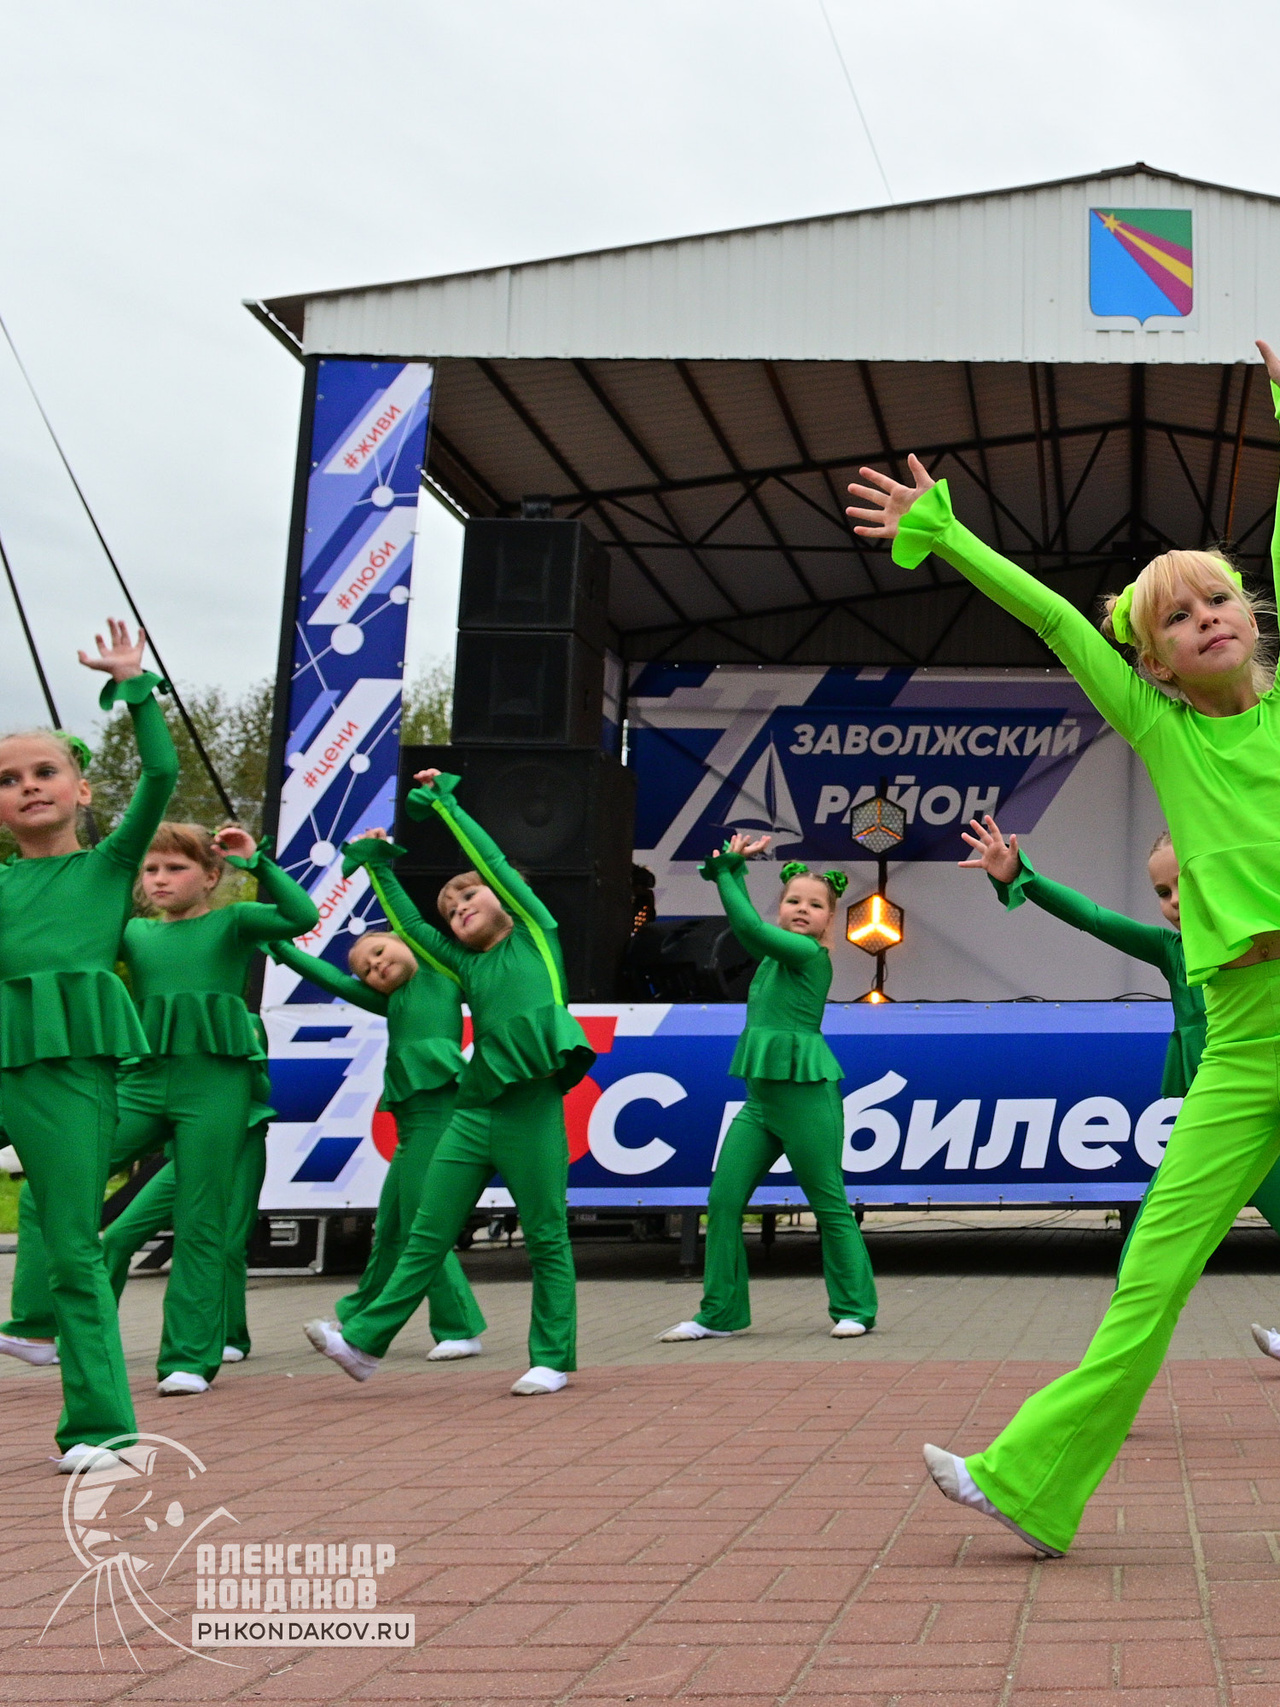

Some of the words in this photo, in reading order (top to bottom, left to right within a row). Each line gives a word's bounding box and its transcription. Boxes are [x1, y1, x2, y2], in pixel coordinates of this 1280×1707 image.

[343, 404, 402, 469] #живи
[337, 540, 396, 611] #люби
[302, 720, 360, 789] #цени
[789, 718, 1083, 756] ЗАВОЛЖСКИЙ
[296, 876, 354, 947] храни
